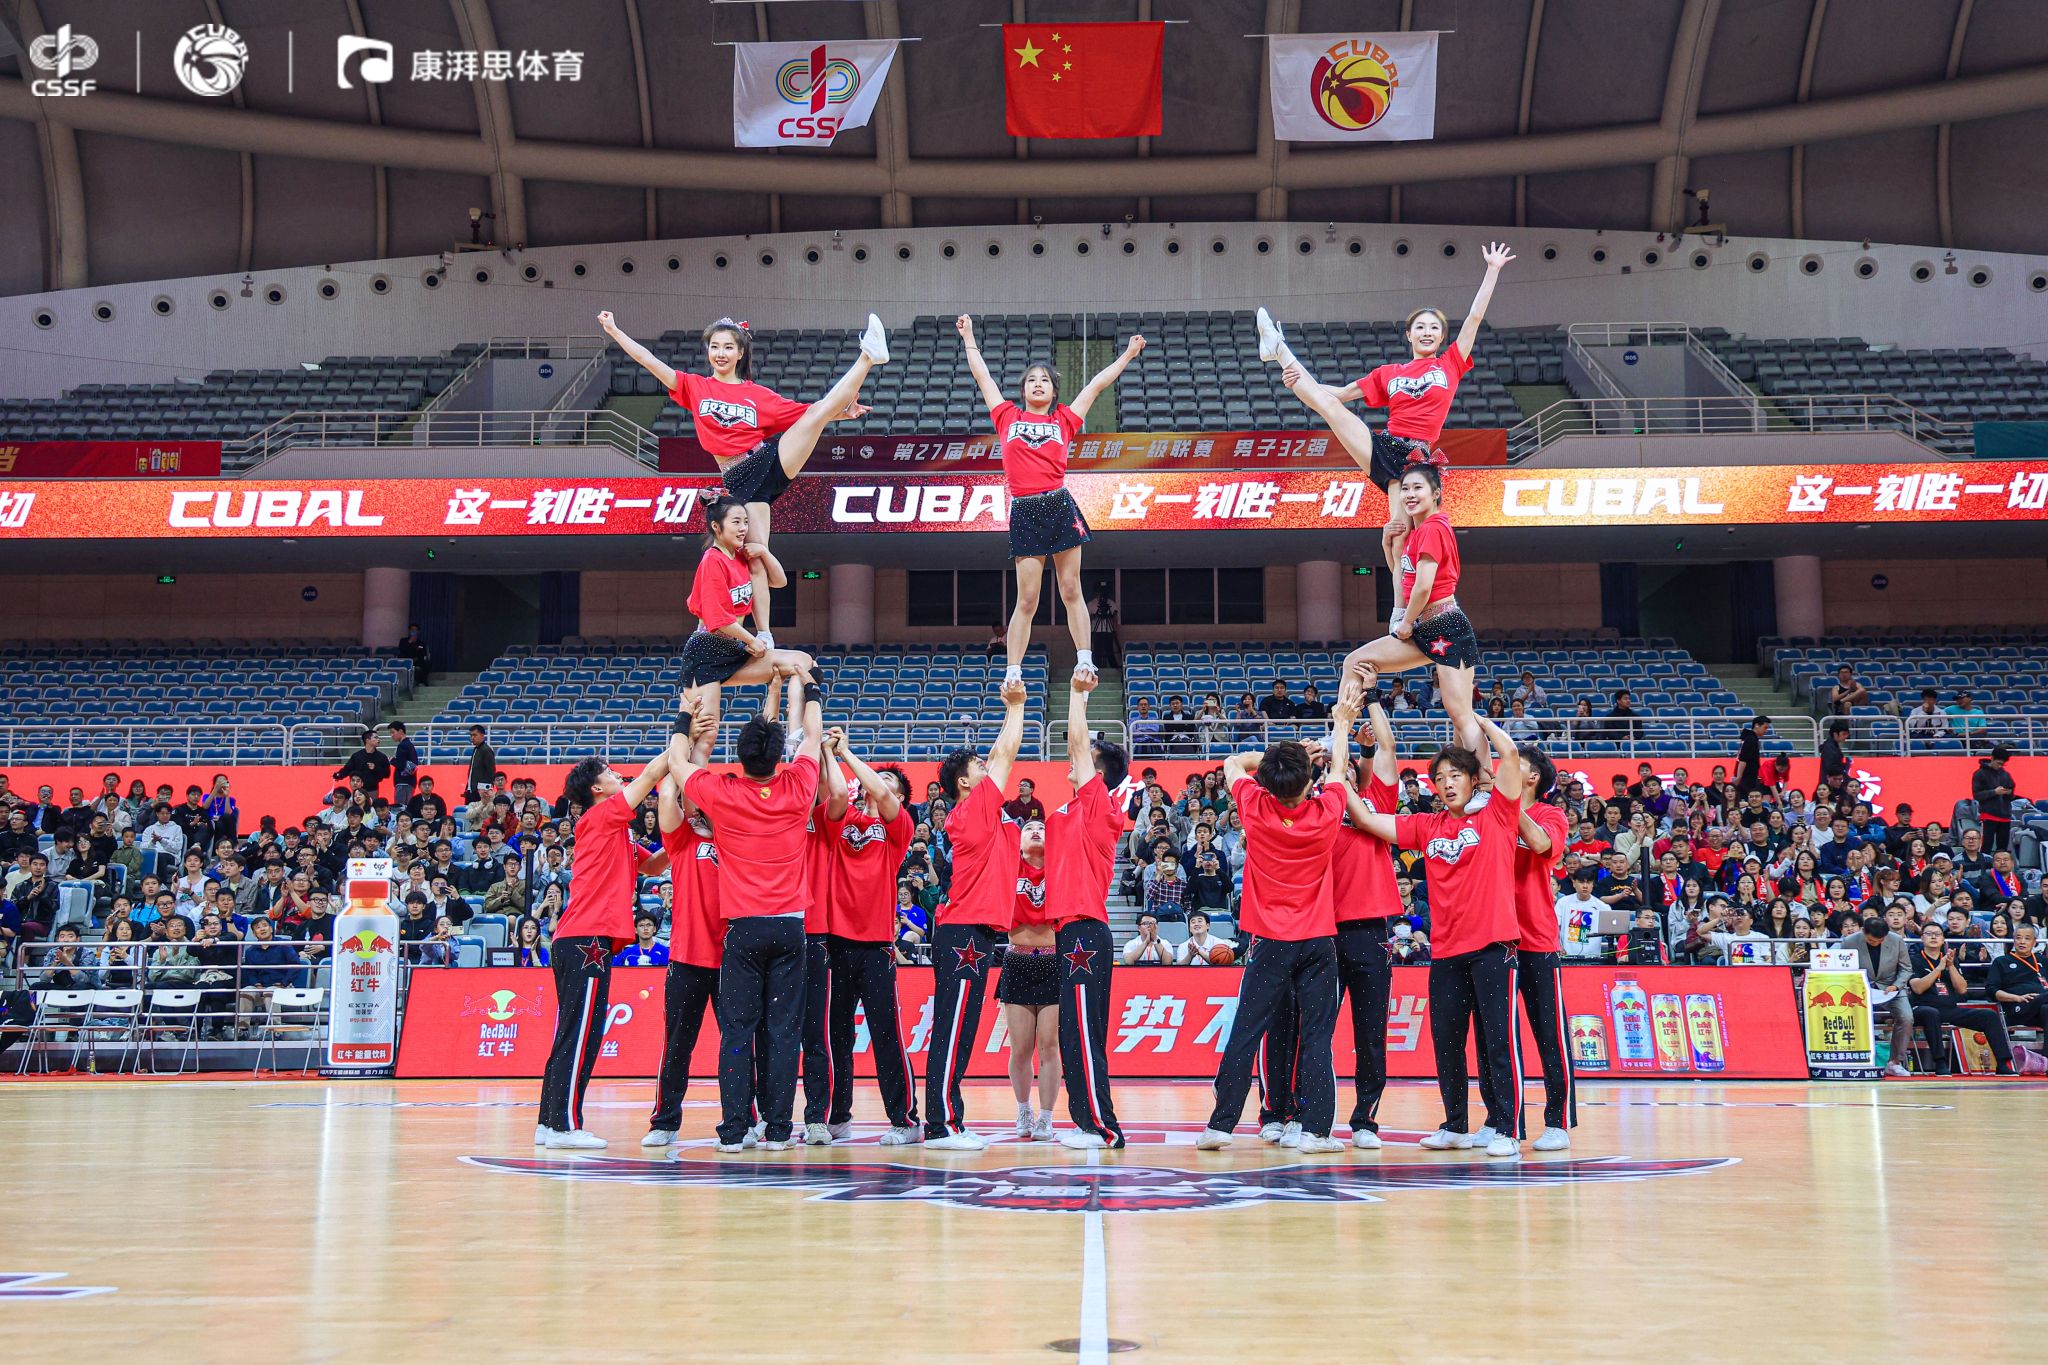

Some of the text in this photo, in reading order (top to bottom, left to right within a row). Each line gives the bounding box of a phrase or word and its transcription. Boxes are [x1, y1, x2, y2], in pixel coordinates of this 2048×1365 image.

[893, 438, 1329, 461] 第27届中国篮球一级联赛 男子32强
[1108, 481, 1365, 519] 这一刻胜一切
[1502, 477, 1725, 517] CUBAL
[1787, 473, 2048, 512] 这一刻胜一切
[0, 491, 36, 528] 切
[168, 490, 385, 528] CUBAL
[444, 486, 700, 525] 这一刻胜一切
[831, 485, 1011, 523] CUBA
[350, 961, 382, 976] RedBull
[350, 977, 380, 993] 红牛
[480, 1022, 518, 1039] RedBull
[1624, 1023, 1642, 1032] 红牛
[1823, 1015, 1855, 1031] RedBull
[1823, 1031, 1856, 1045] 红牛
[477, 1040, 515, 1057] 红牛
[601, 1040, 619, 1057] 丝
[1581, 1049, 1598, 1057] 红牛
